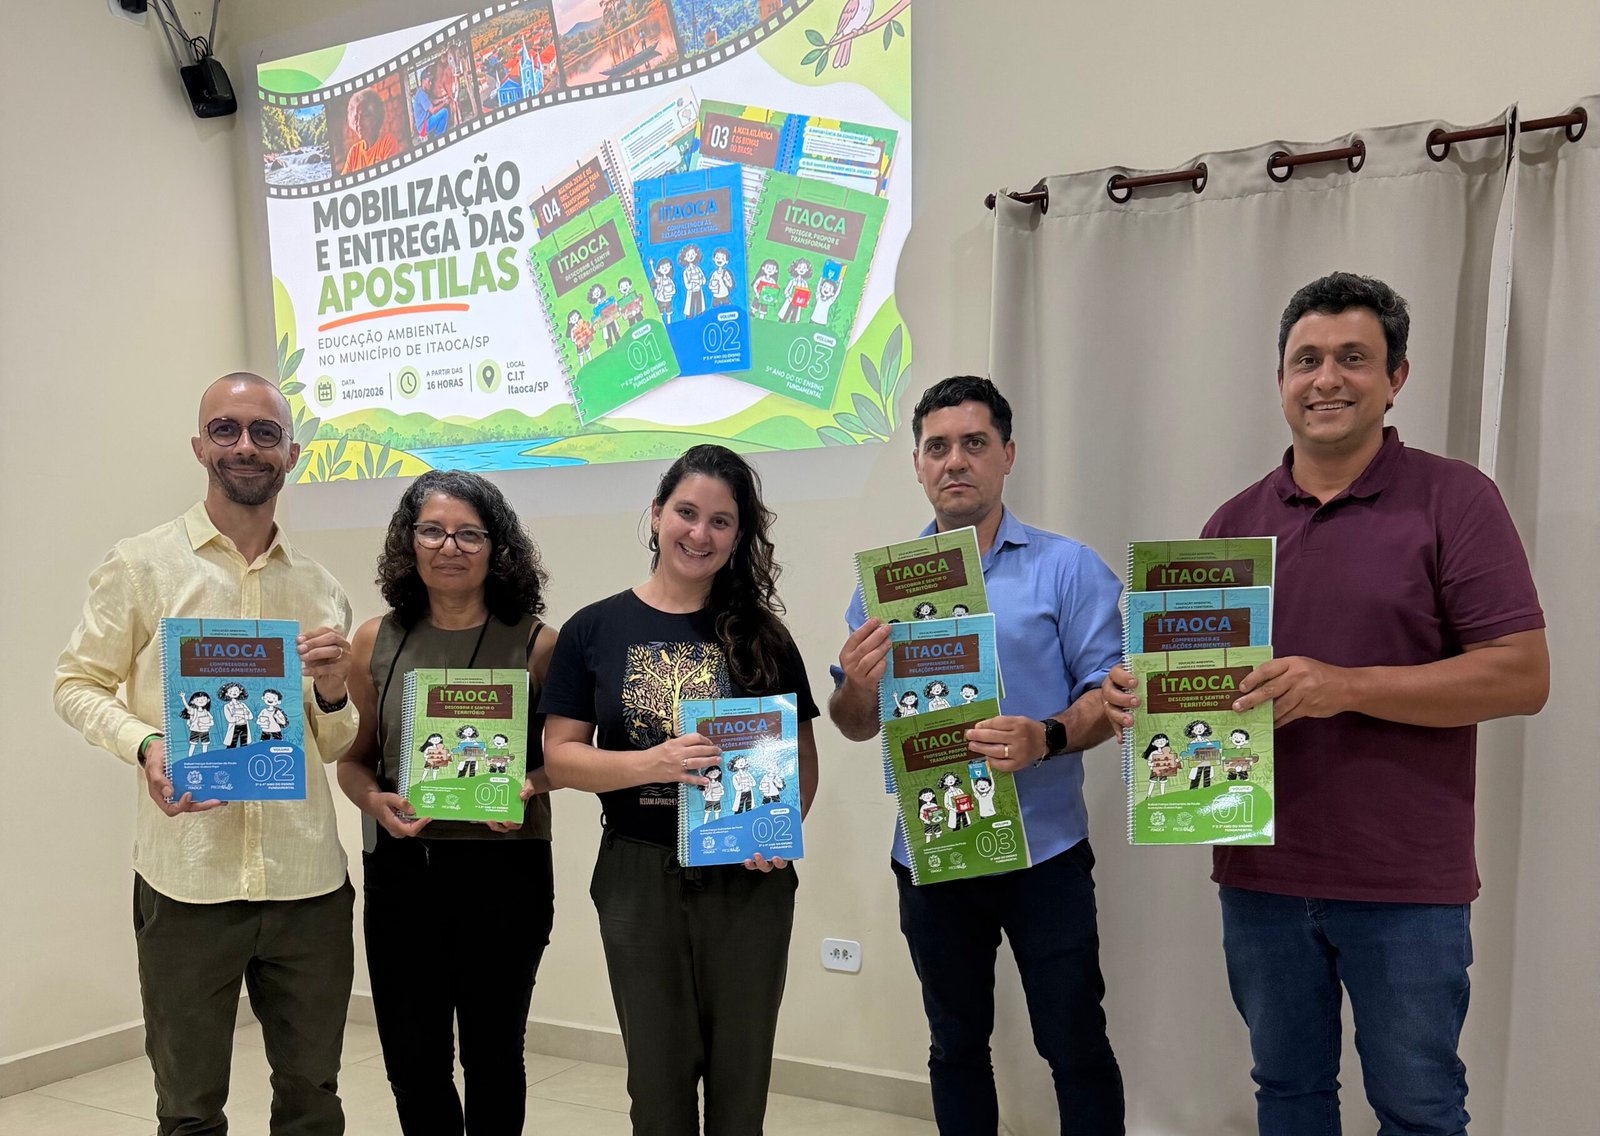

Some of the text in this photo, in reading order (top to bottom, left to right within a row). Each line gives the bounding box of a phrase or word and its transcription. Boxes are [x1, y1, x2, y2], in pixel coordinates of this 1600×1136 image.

[710, 124, 729, 149] 03
[313, 153, 520, 233] MOBILIZAÇÃO
[542, 197, 561, 223] 04
[658, 197, 717, 224] ITAOCA
[784, 205, 846, 235] ITAOCA
[316, 239, 330, 271] E
[338, 218, 460, 268] ENTREGA
[469, 206, 524, 248] DAS
[557, 234, 609, 274] ITAOCA
[318, 247, 519, 315] APOSTILAS
[318, 322, 456, 349] EDUCAÇÃO AMBIENTAL
[703, 321, 740, 353] 02
[319, 336, 490, 366] NO MUNICÍPIO DE ITAOCA/SP
[628, 332, 661, 371] 01
[788, 337, 833, 380] 03
[427, 378, 463, 390] 16 HORAS
[507, 371, 524, 382] C.I.T
[508, 381, 549, 394] Itaoca/SP
[342, 387, 384, 399] 14/10/2026
[886, 558, 949, 582] ITAOCA
[1161, 568, 1234, 584] ITAOCA
[1158, 616, 1231, 633] ITAOCA
[195, 643, 267, 657] ITAOCA
[905, 642, 964, 659] ITAOCA
[440, 690, 498, 702] ITAOCA
[1161, 675, 1234, 692] ITAOCA
[708, 719, 768, 735] ITAOCA
[248, 754, 295, 782] 02
[475, 783, 509, 806] 01
[752, 815, 792, 843] 02
[976, 828, 1016, 857] 03
